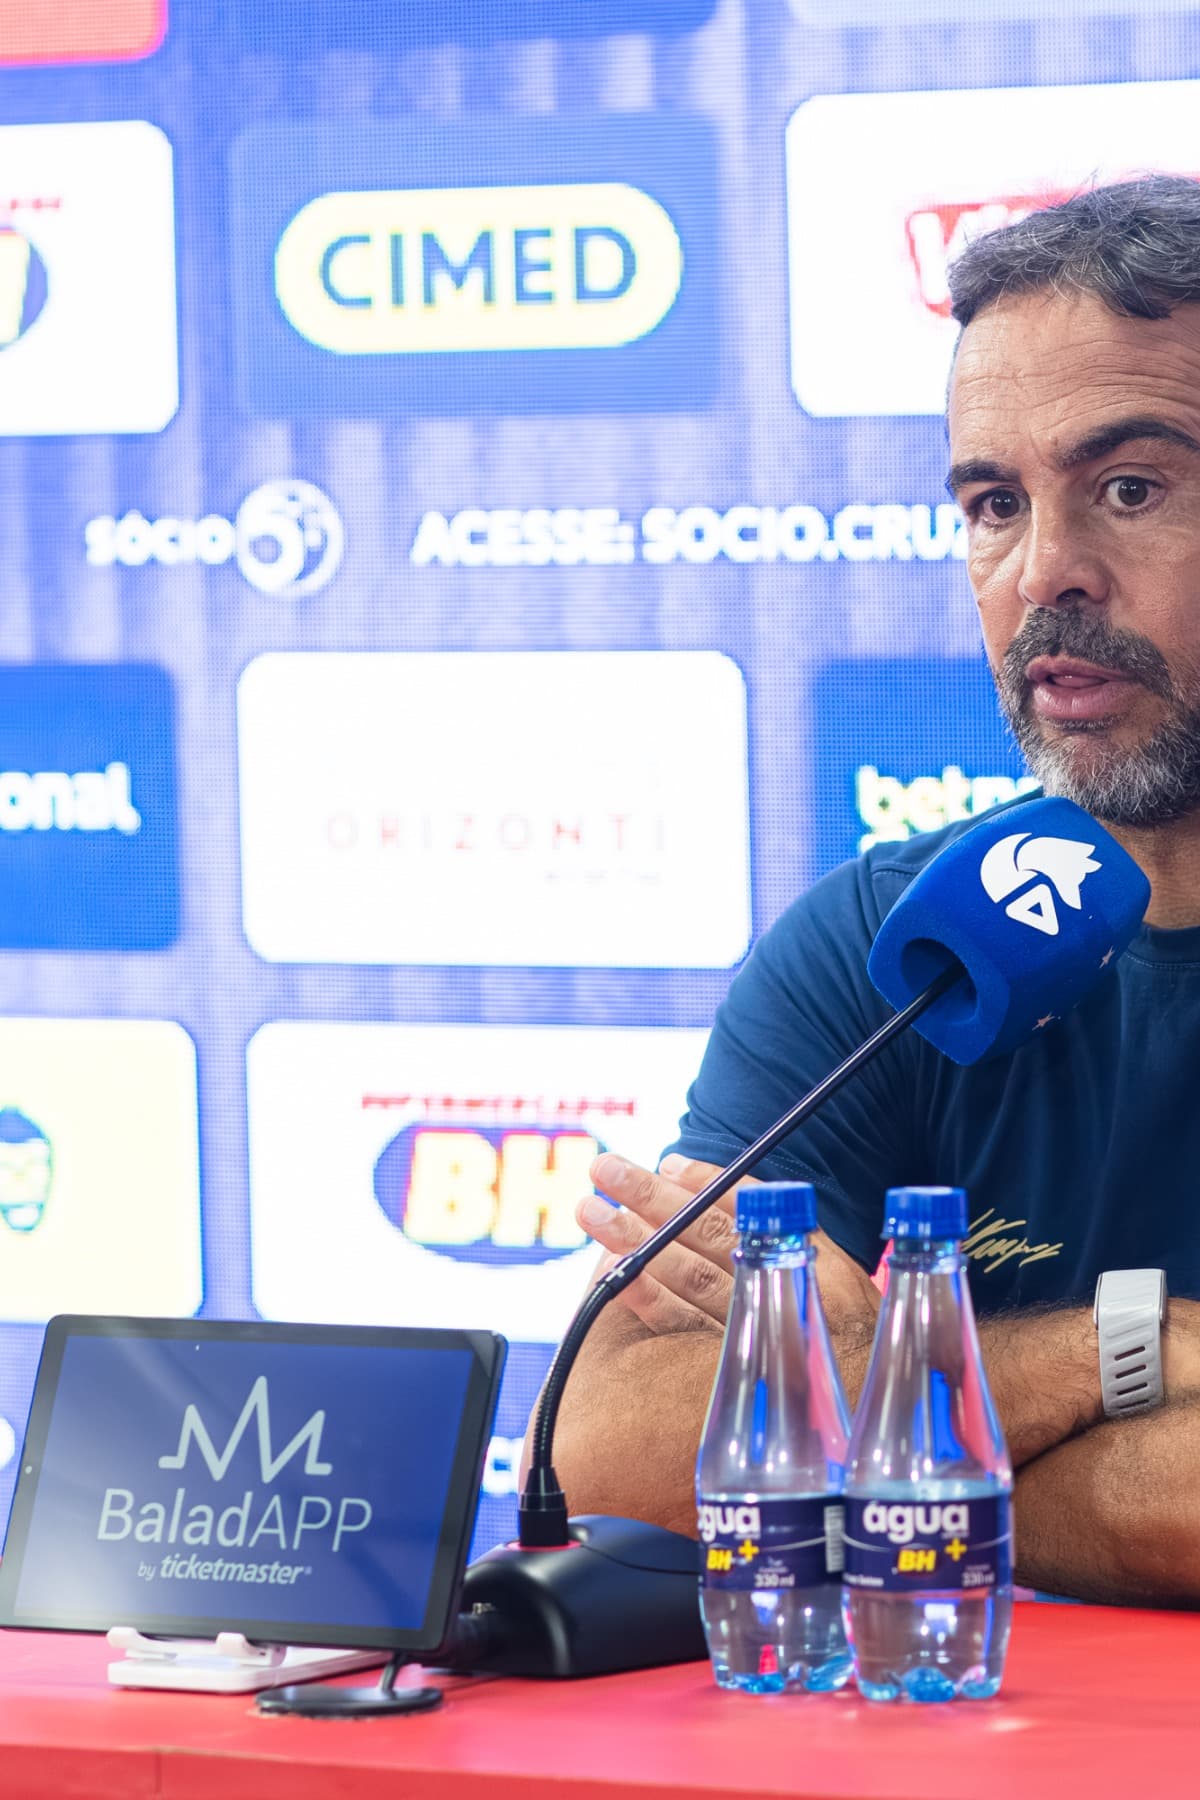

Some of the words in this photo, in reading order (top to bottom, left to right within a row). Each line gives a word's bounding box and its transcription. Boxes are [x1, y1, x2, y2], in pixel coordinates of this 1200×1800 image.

[320, 225, 637, 309] CIMED
[410, 508, 634, 567] ACESSE:
[857, 765, 1043, 833] betn
[404, 1128, 600, 1248] BH
[97, 1487, 372, 1552] BaladAPP
[698, 1504, 761, 1542] gua
[862, 1500, 969, 1543] água
[137, 1561, 156, 1582] by
[159, 1553, 304, 1585] ticketmaster
[706, 1548, 733, 1571] BH
[897, 1548, 938, 1572] BH
